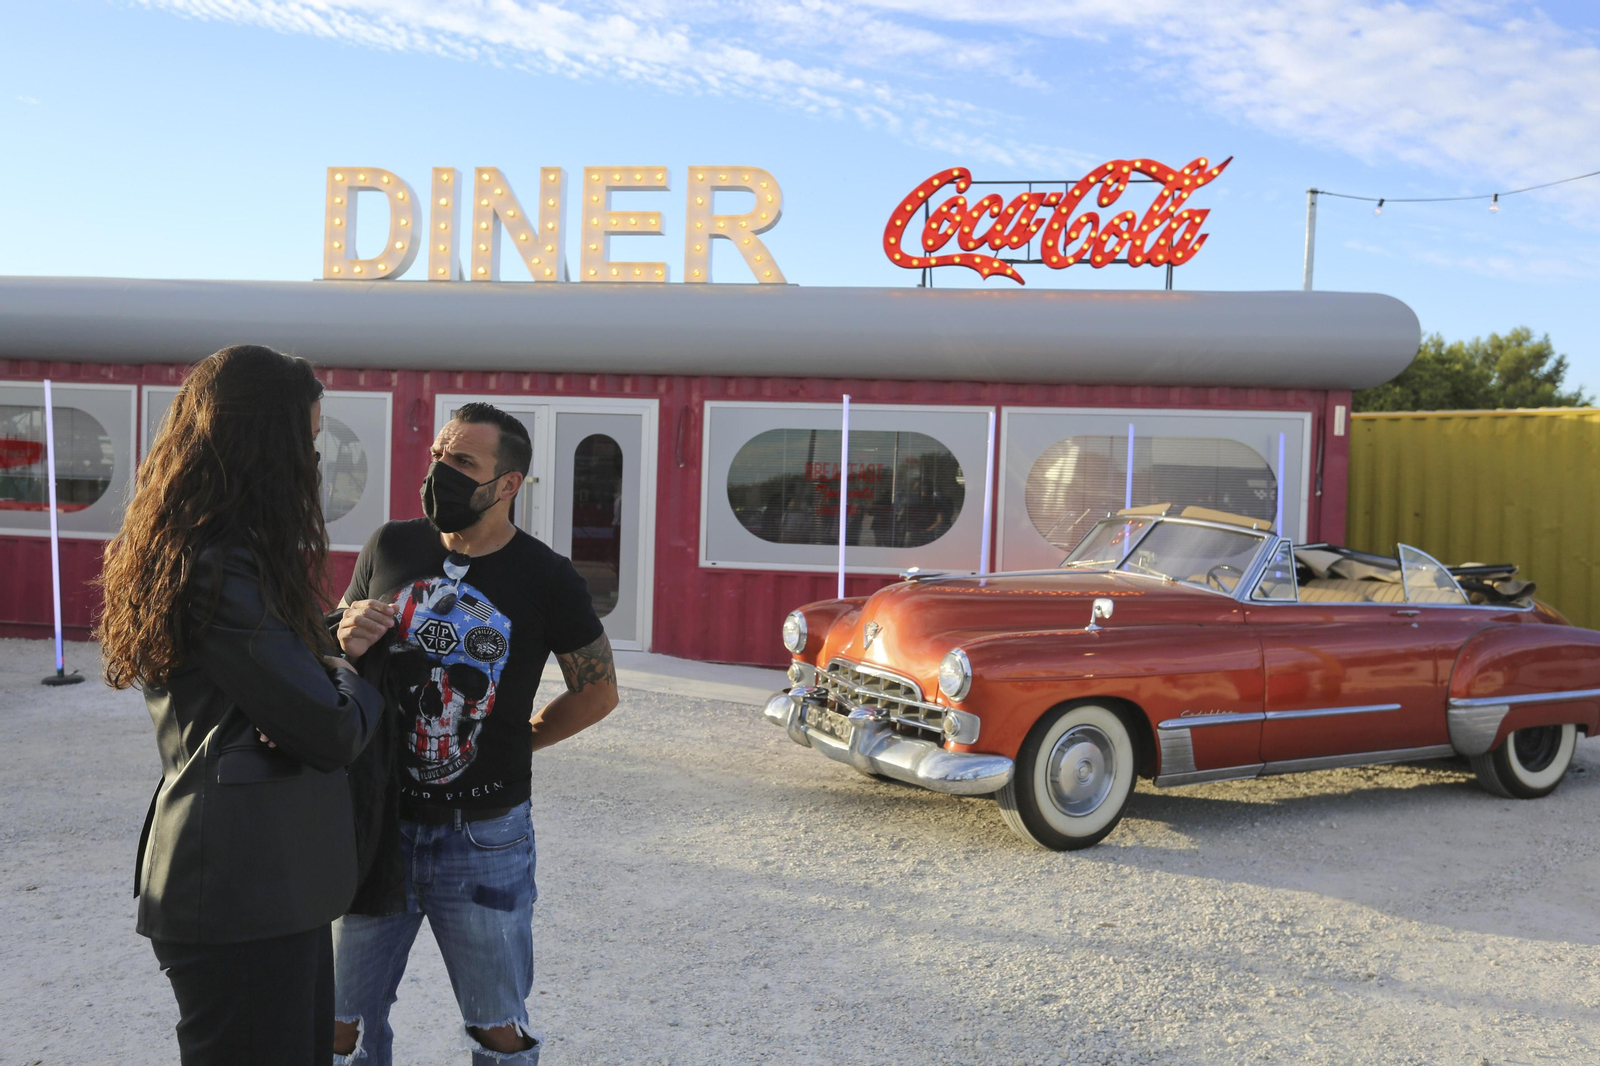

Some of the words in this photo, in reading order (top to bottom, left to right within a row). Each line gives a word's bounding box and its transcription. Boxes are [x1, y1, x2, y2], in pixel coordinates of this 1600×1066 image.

[323, 166, 787, 283] DINER
[883, 156, 1234, 285] Coca-Cola
[805, 462, 885, 482] BREAFAST
[423, 769, 440, 779] LOVE
[440, 763, 455, 775] NEW
